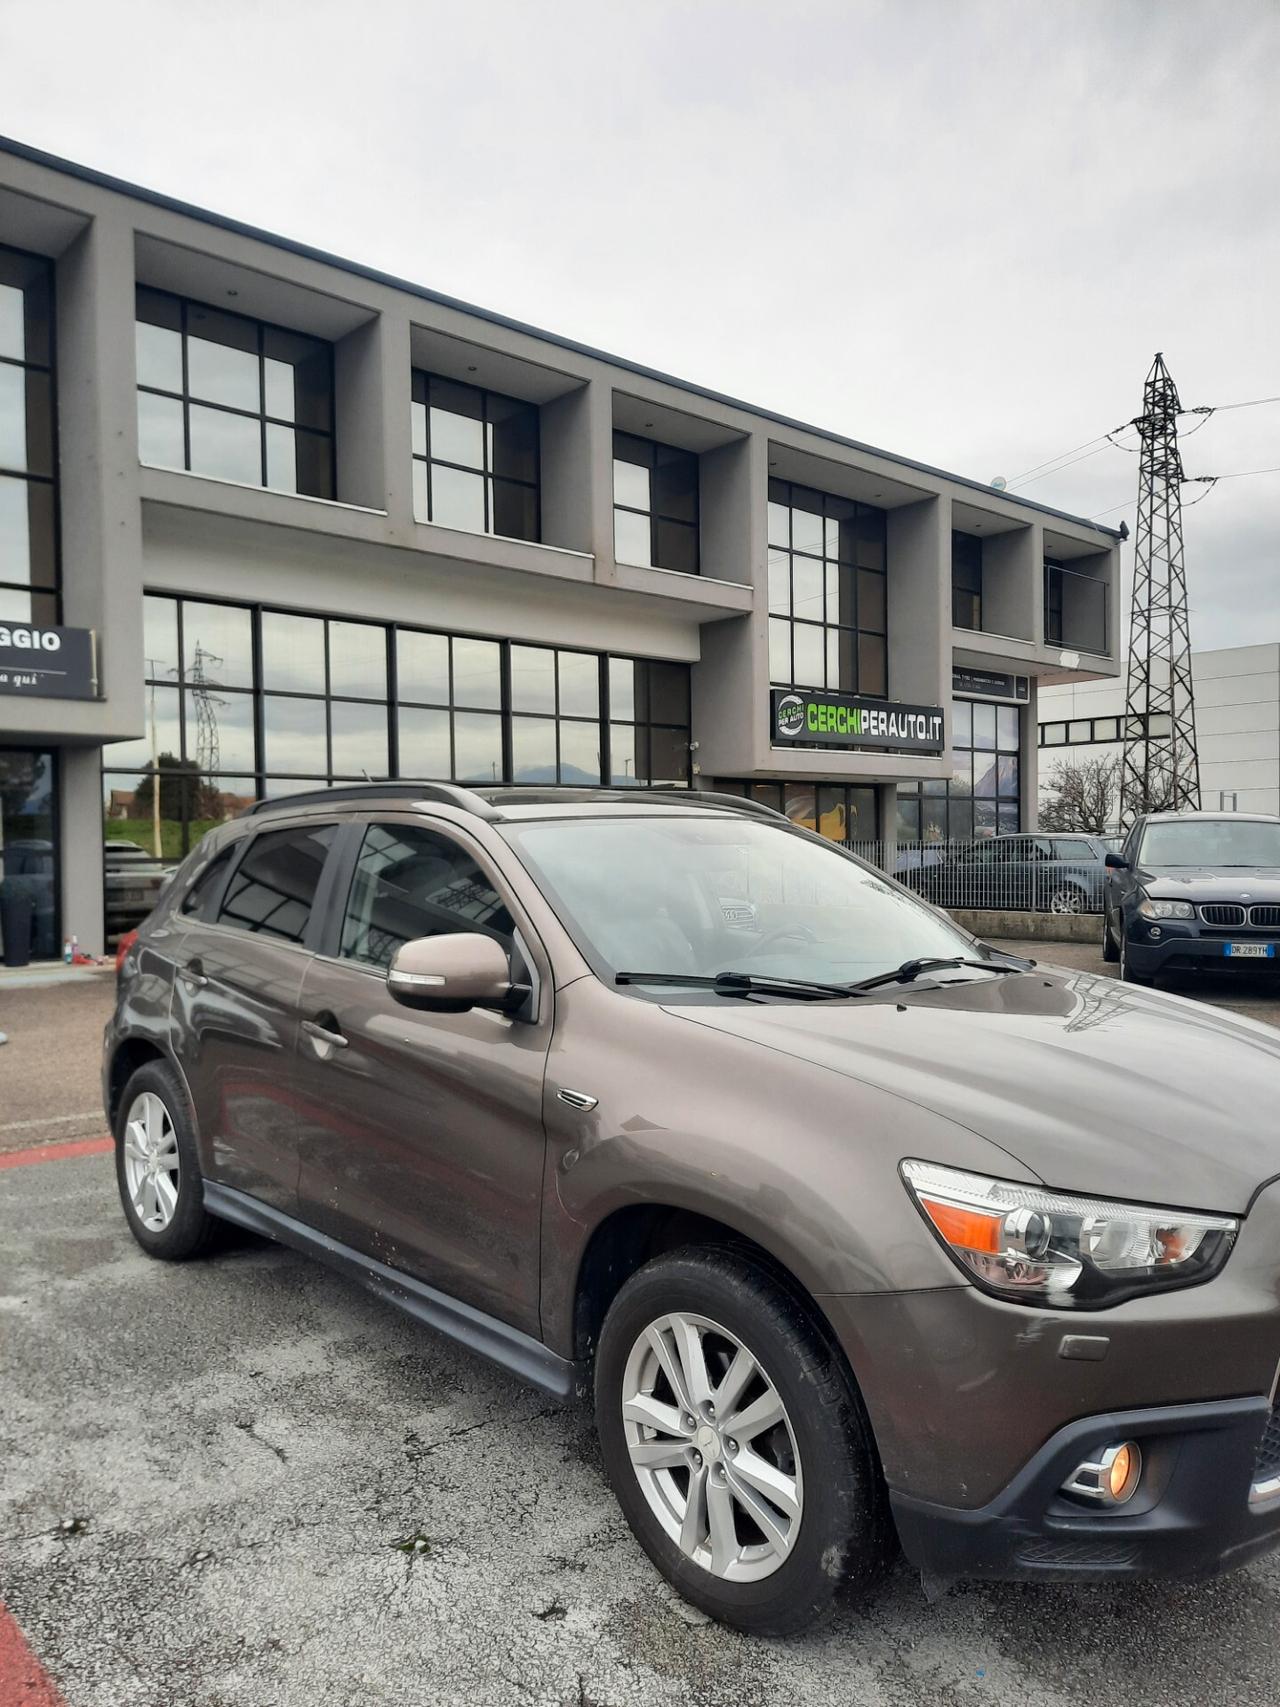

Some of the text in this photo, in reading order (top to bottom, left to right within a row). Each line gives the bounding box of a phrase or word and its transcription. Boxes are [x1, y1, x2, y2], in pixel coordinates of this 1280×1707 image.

[778, 704, 805, 719] CERCHI
[778, 711, 804, 727] PER AUTO
